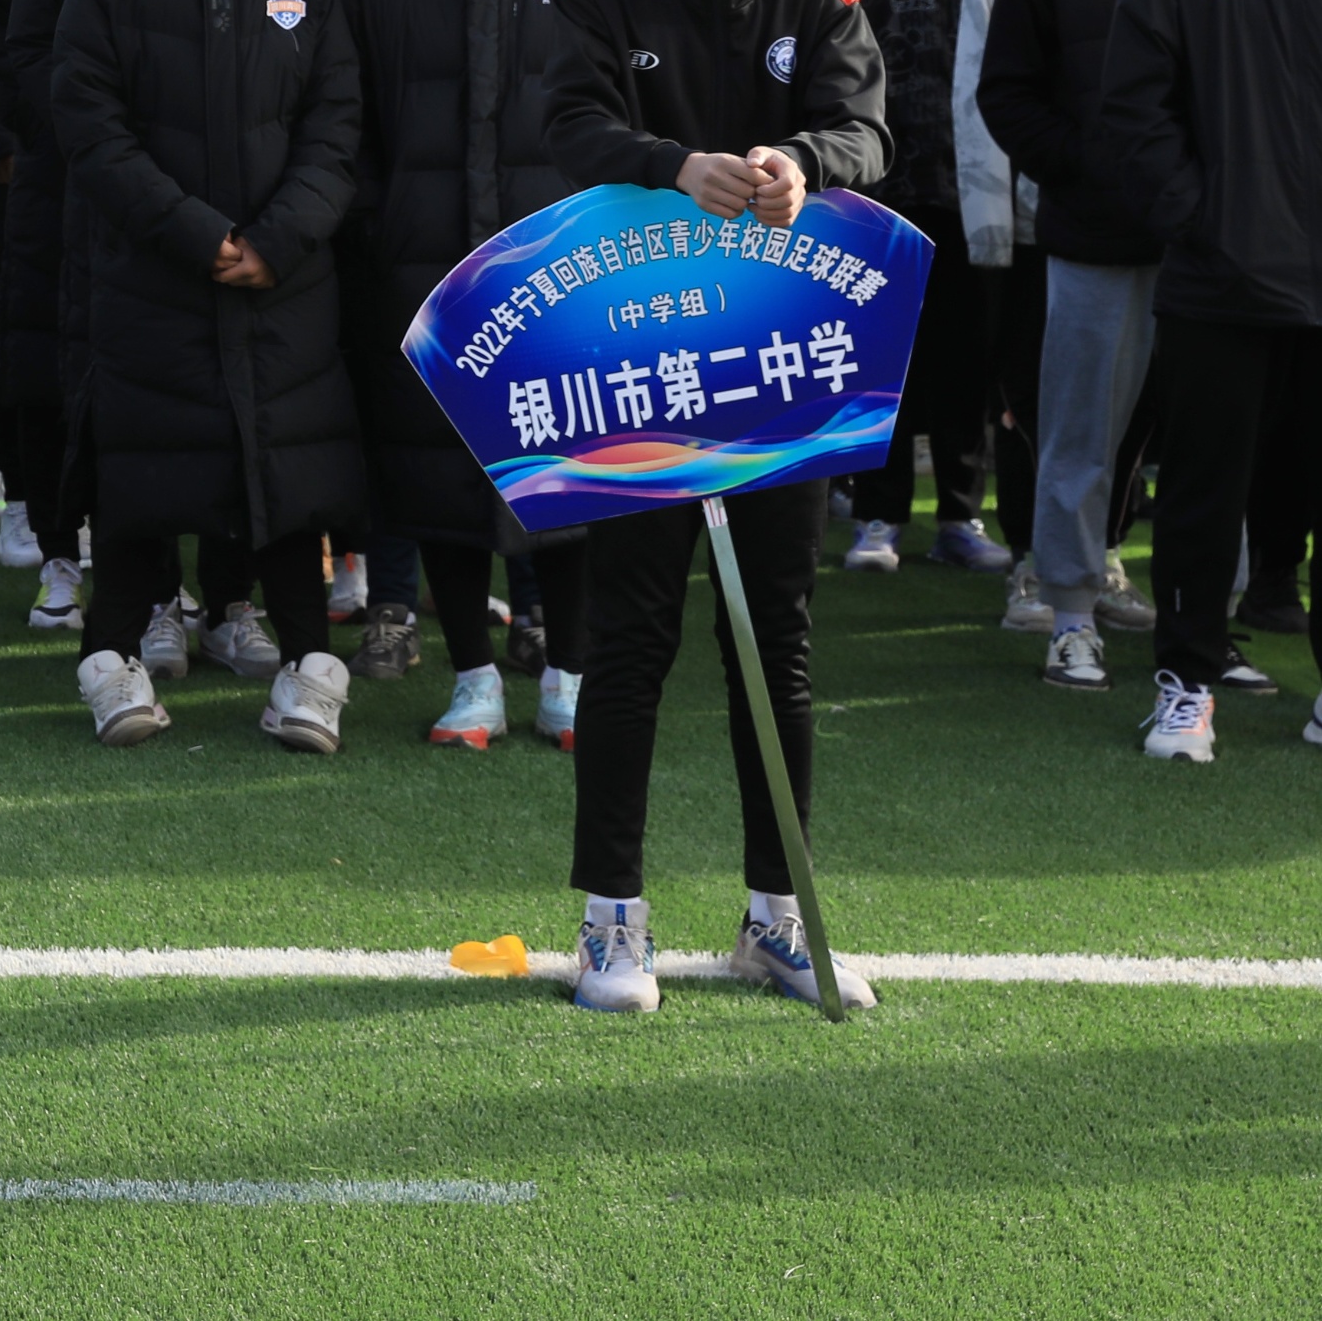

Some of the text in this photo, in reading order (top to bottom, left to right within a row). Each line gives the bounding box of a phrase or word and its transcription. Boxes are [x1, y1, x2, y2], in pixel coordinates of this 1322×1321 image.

[455, 218, 888, 378] 2022年宁夏回族自治区青少年校园足球联赛
[507, 319, 859, 450] 银川市第二中学
